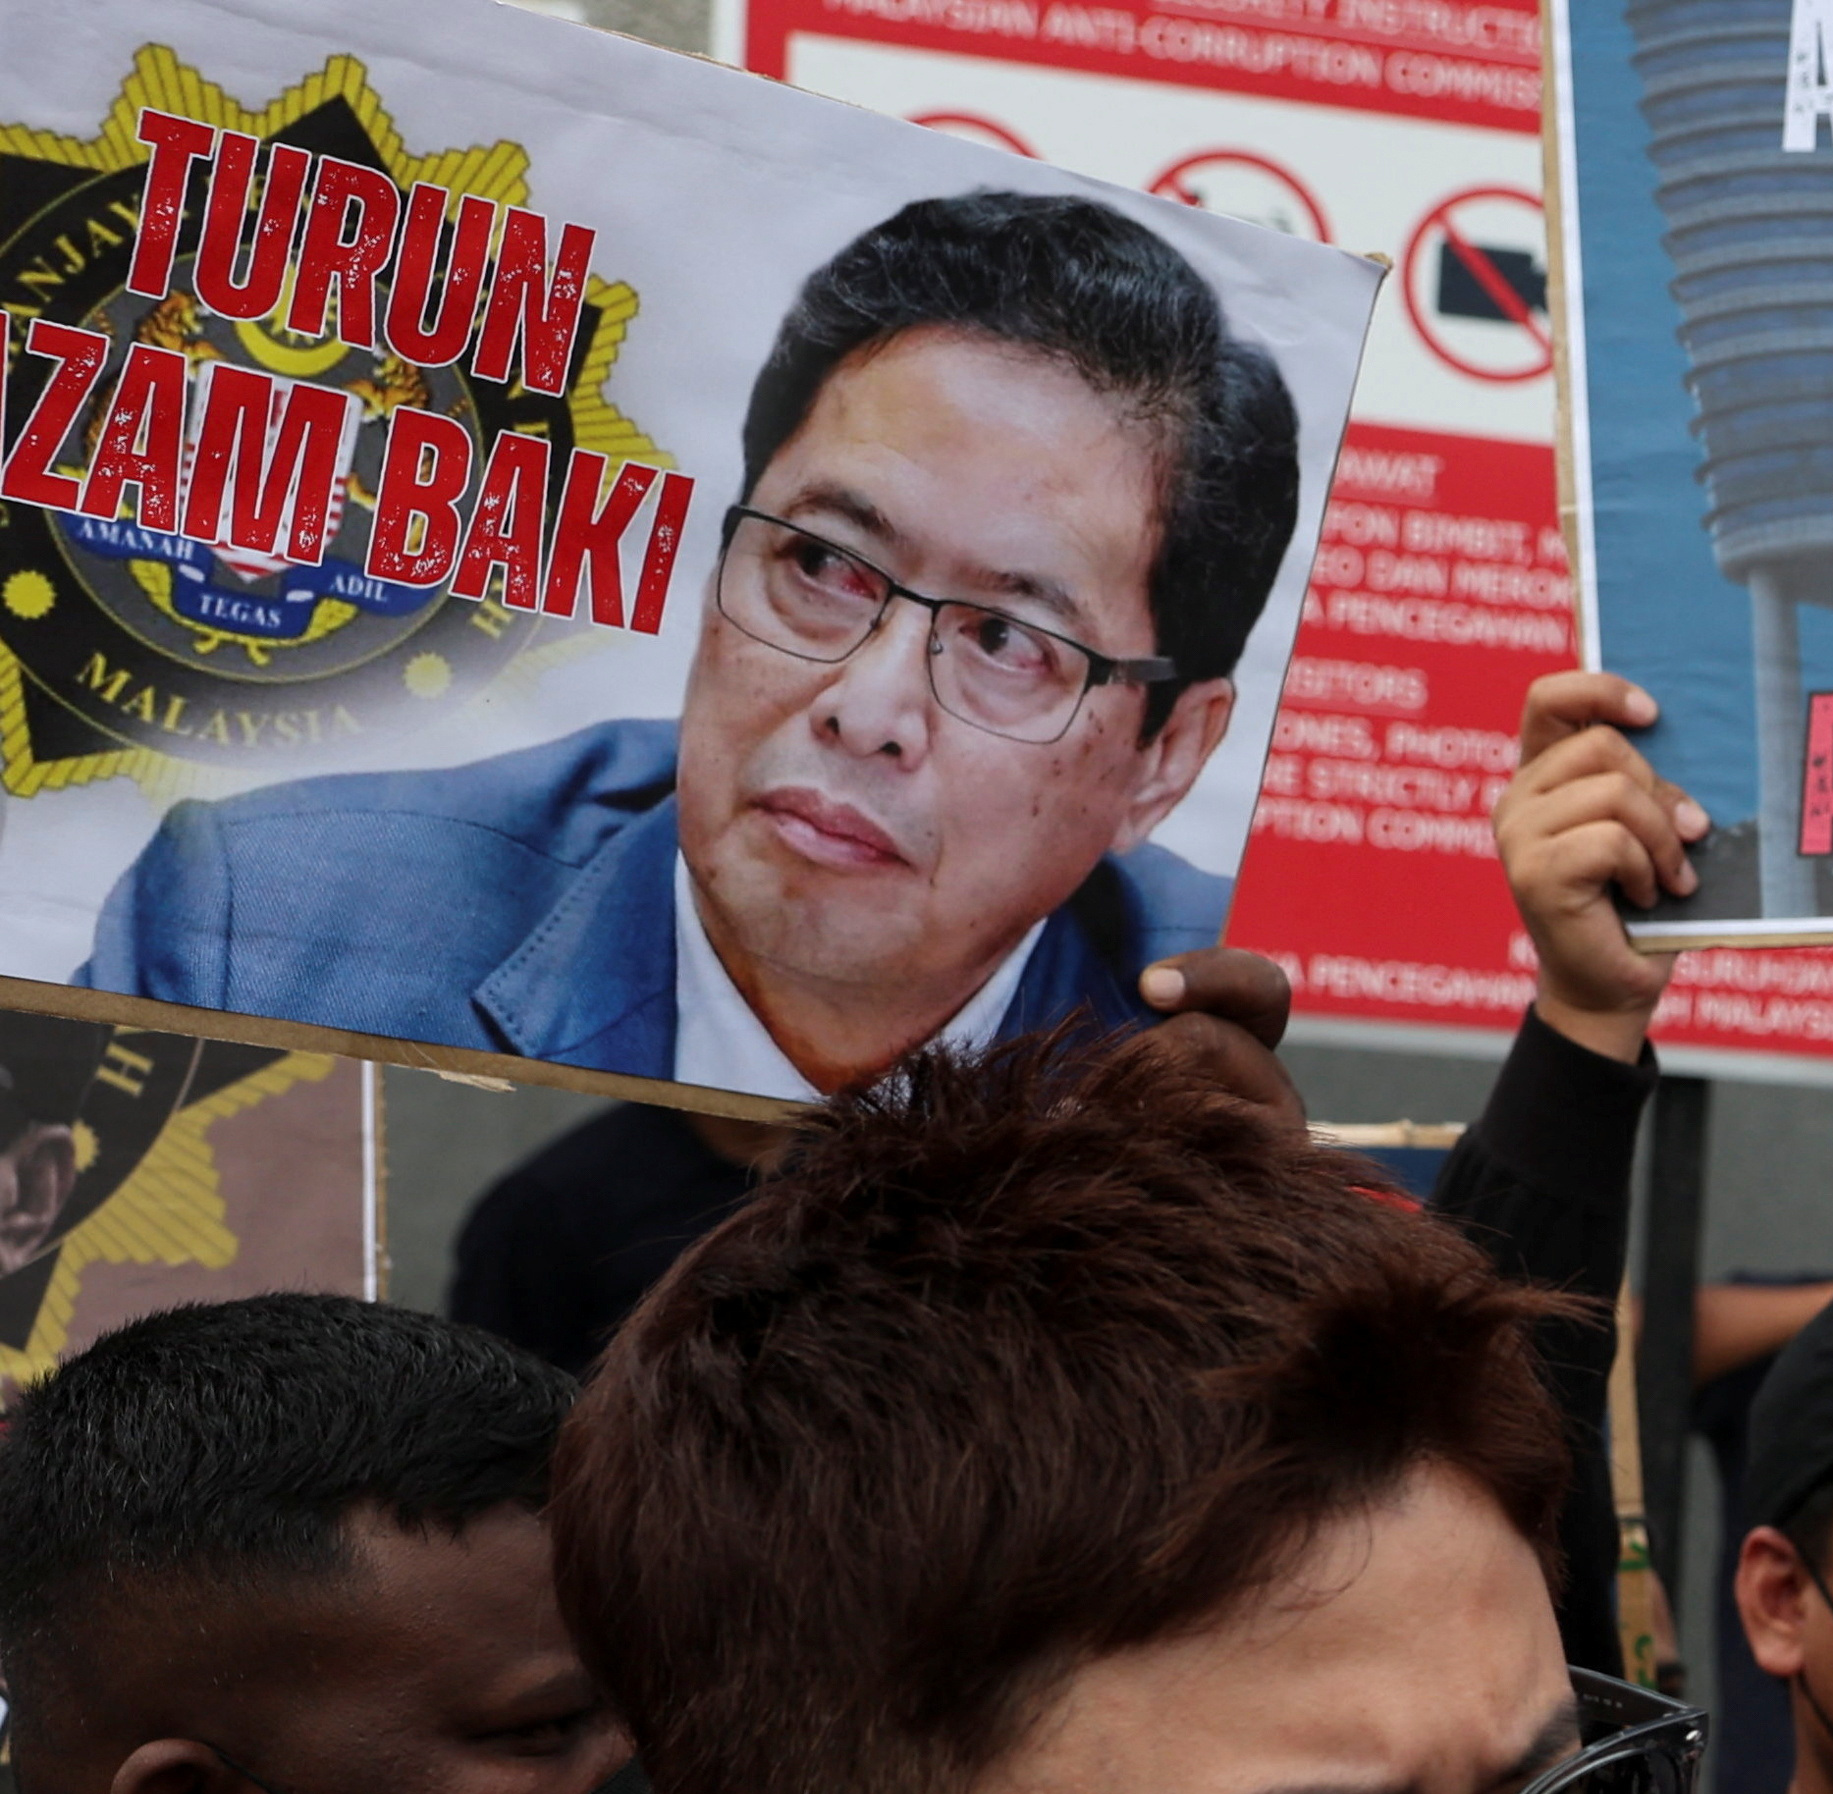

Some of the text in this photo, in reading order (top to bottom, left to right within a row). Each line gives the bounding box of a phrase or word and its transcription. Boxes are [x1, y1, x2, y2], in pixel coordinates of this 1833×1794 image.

[126, 107, 596, 398] TURUN
[0, 310, 695, 636] ZAM BAKI
[79, 517, 195, 562] AMANAH
[199, 593, 283, 629] TEGAS
[329, 573, 389, 604] ADIL
[75, 652, 363, 749] MALAYSIA
